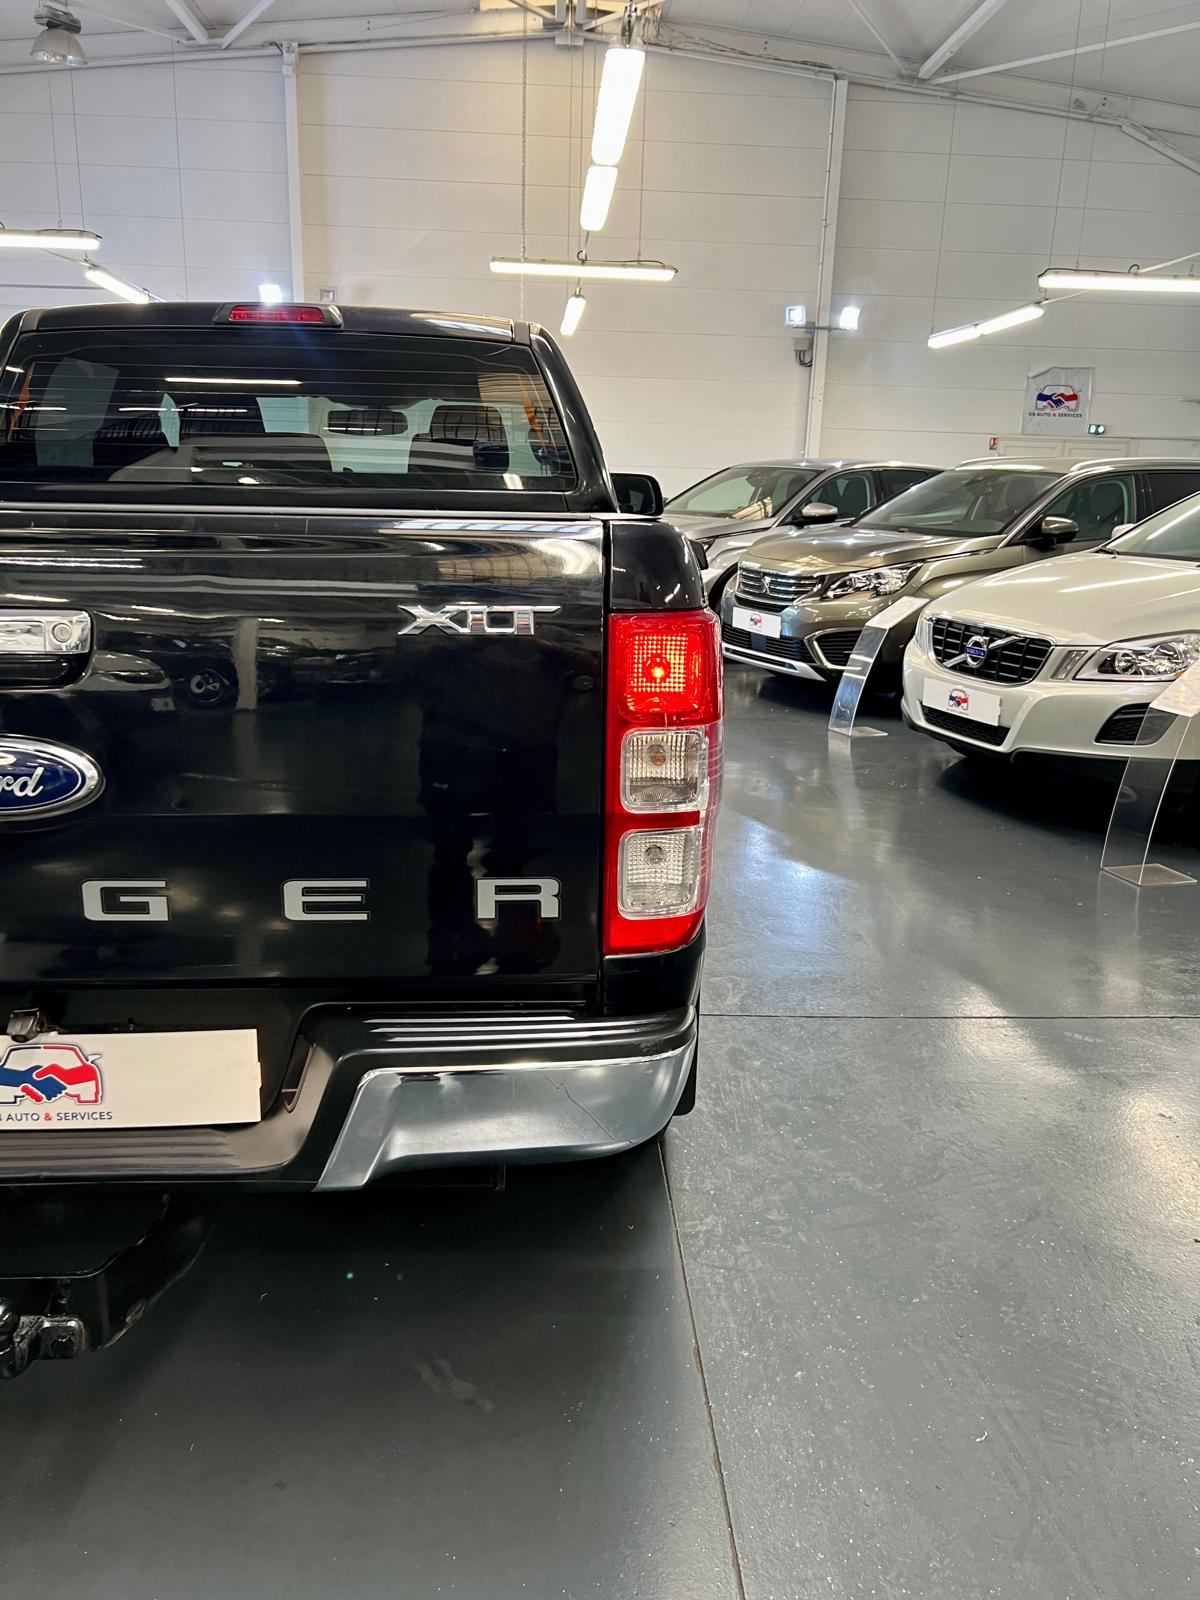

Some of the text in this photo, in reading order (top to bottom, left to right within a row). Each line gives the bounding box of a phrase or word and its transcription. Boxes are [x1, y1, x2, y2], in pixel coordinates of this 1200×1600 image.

[398, 605, 562, 636] XLT
[6, 1113, 40, 1121] AUTO
[44, 1112, 52, 1121] &
[56, 1111, 113, 1121] SERVICES
